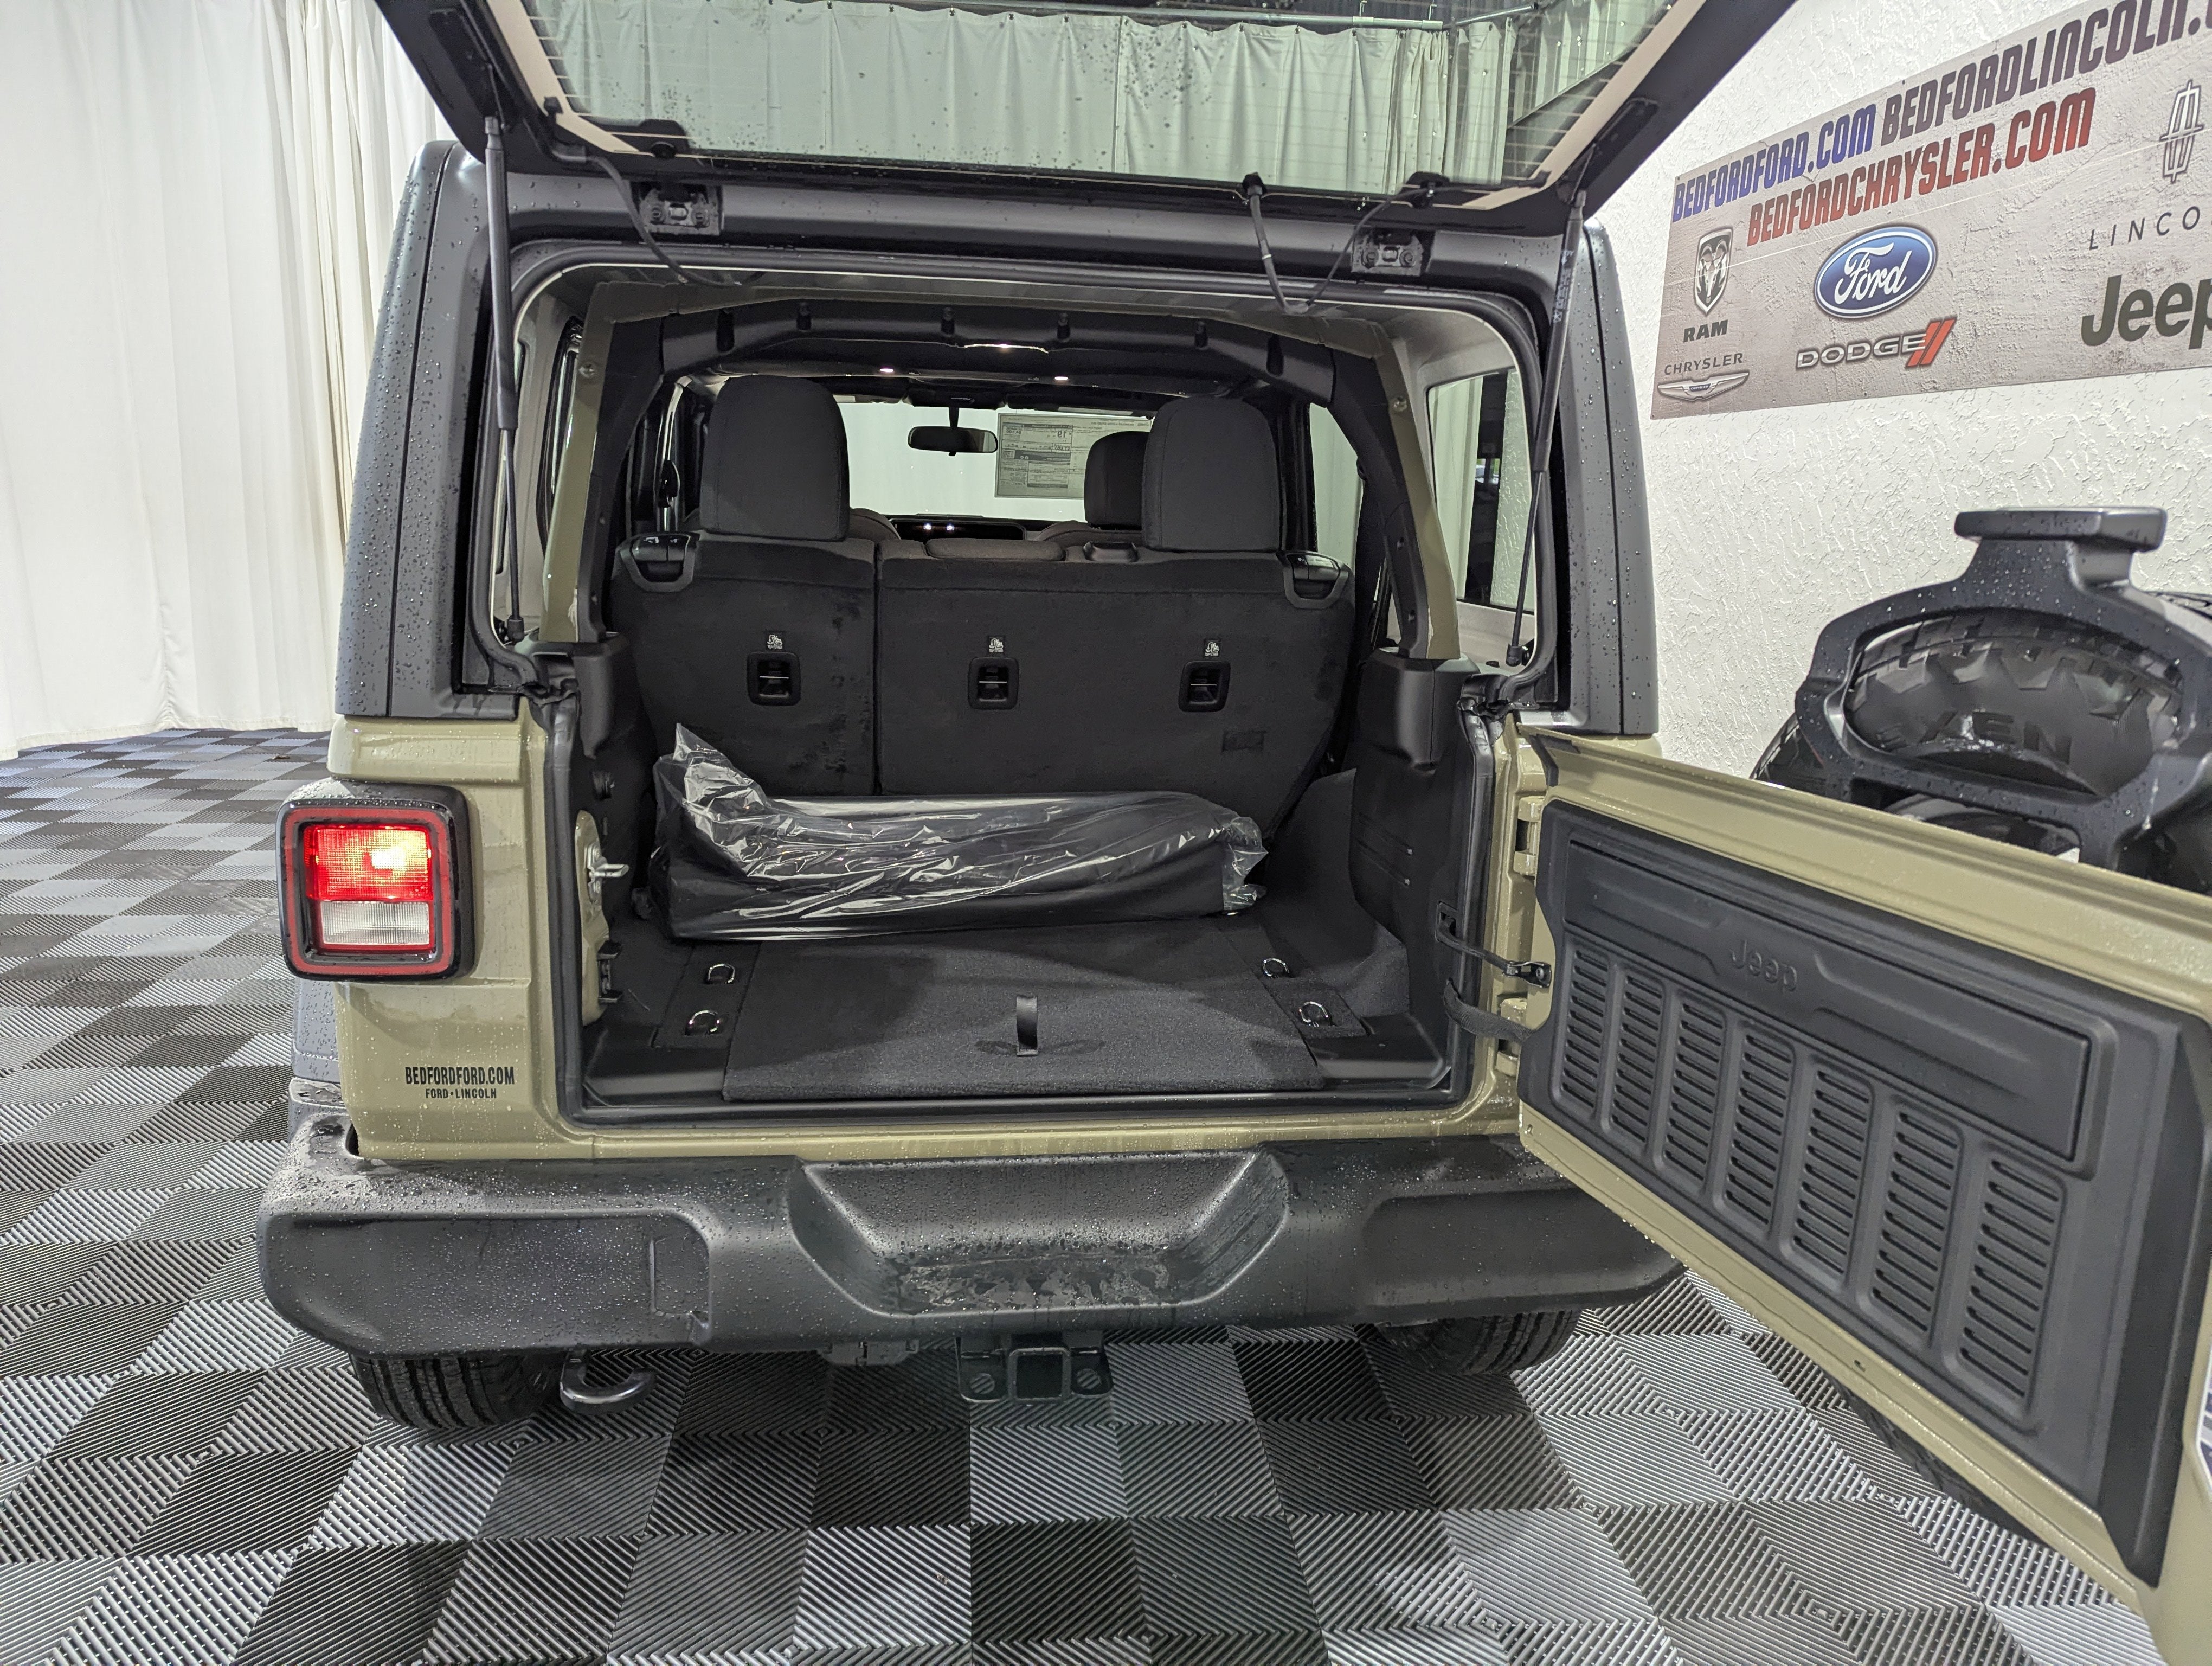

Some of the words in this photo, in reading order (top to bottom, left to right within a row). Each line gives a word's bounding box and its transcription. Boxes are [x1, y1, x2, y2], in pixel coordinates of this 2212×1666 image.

[1672, 103, 1876, 223] BEDFORDFORD.COM
[1880, 0, 2212, 146] BEDFORDLINCOLN.
[1747, 87, 2096, 247] BEDFORDCHRYSLER.COM
[2089, 206, 2212, 251] LINCO
[1834, 242, 1912, 305] Ford
[1683, 319, 1728, 343] RAM
[1796, 332, 1927, 369] DODGE
[1664, 353, 1744, 375] CHRYSLER
[1729, 939, 1798, 997] Jeep
[405, 1066, 515, 1085] BEDFORDFORD.COM
[426, 1088, 449, 1099] FORD
[455, 1088, 497, 1099] LINCOLN
